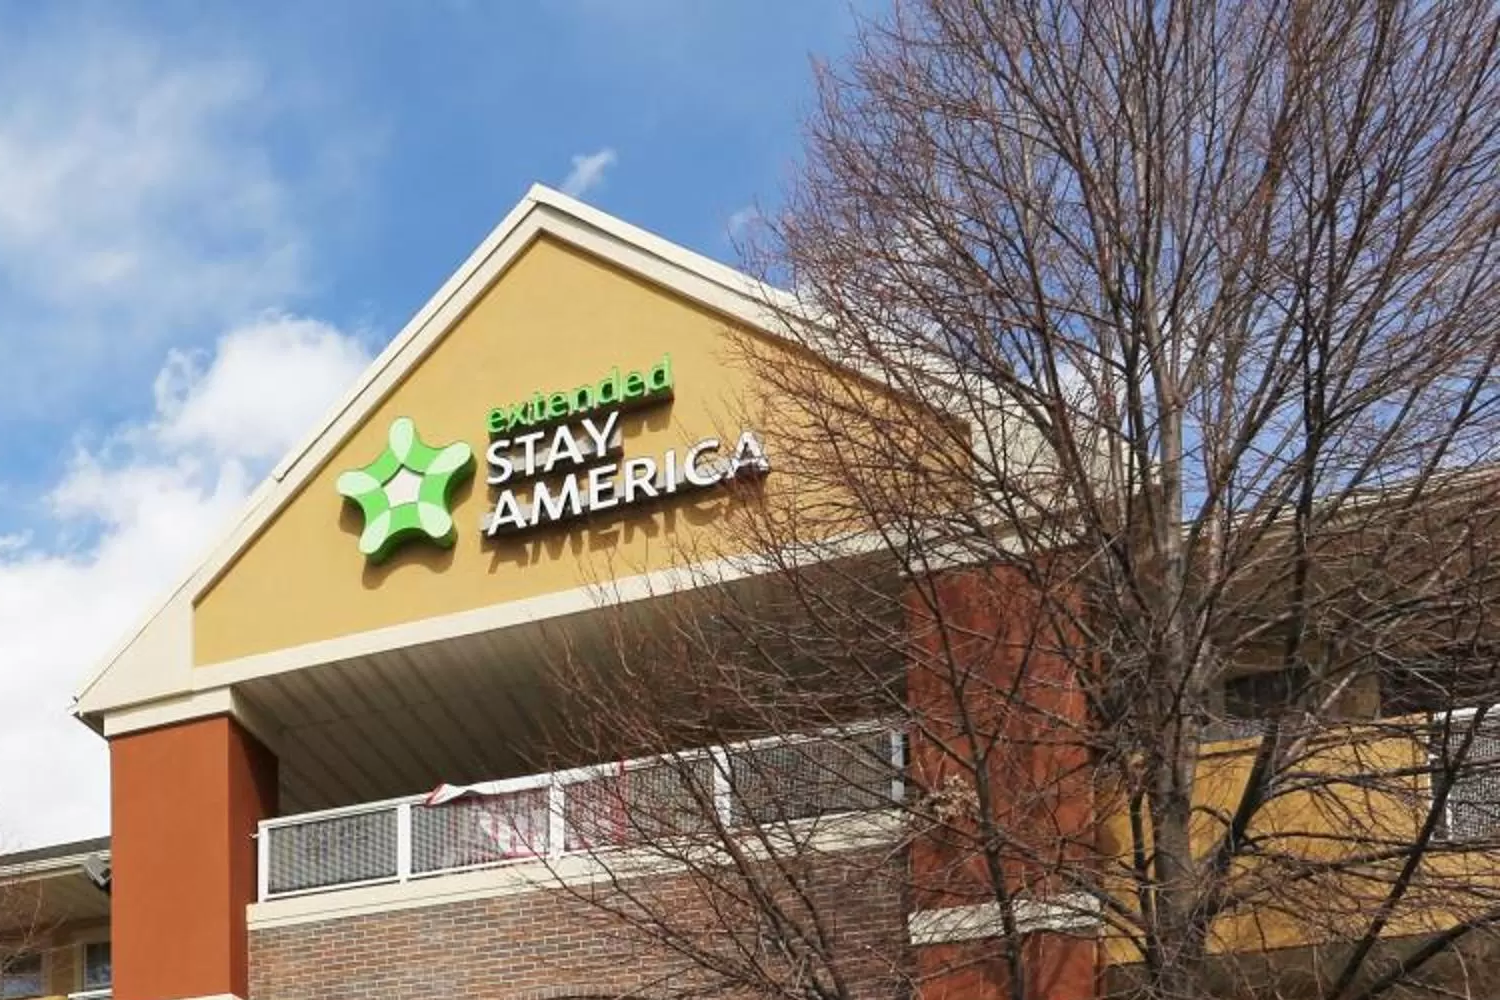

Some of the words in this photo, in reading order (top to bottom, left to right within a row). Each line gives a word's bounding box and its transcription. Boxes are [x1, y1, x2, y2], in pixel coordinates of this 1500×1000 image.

[486, 354, 673, 433] extended
[485, 430, 769, 535] AMERICA
[486, 411, 619, 484] STAY
